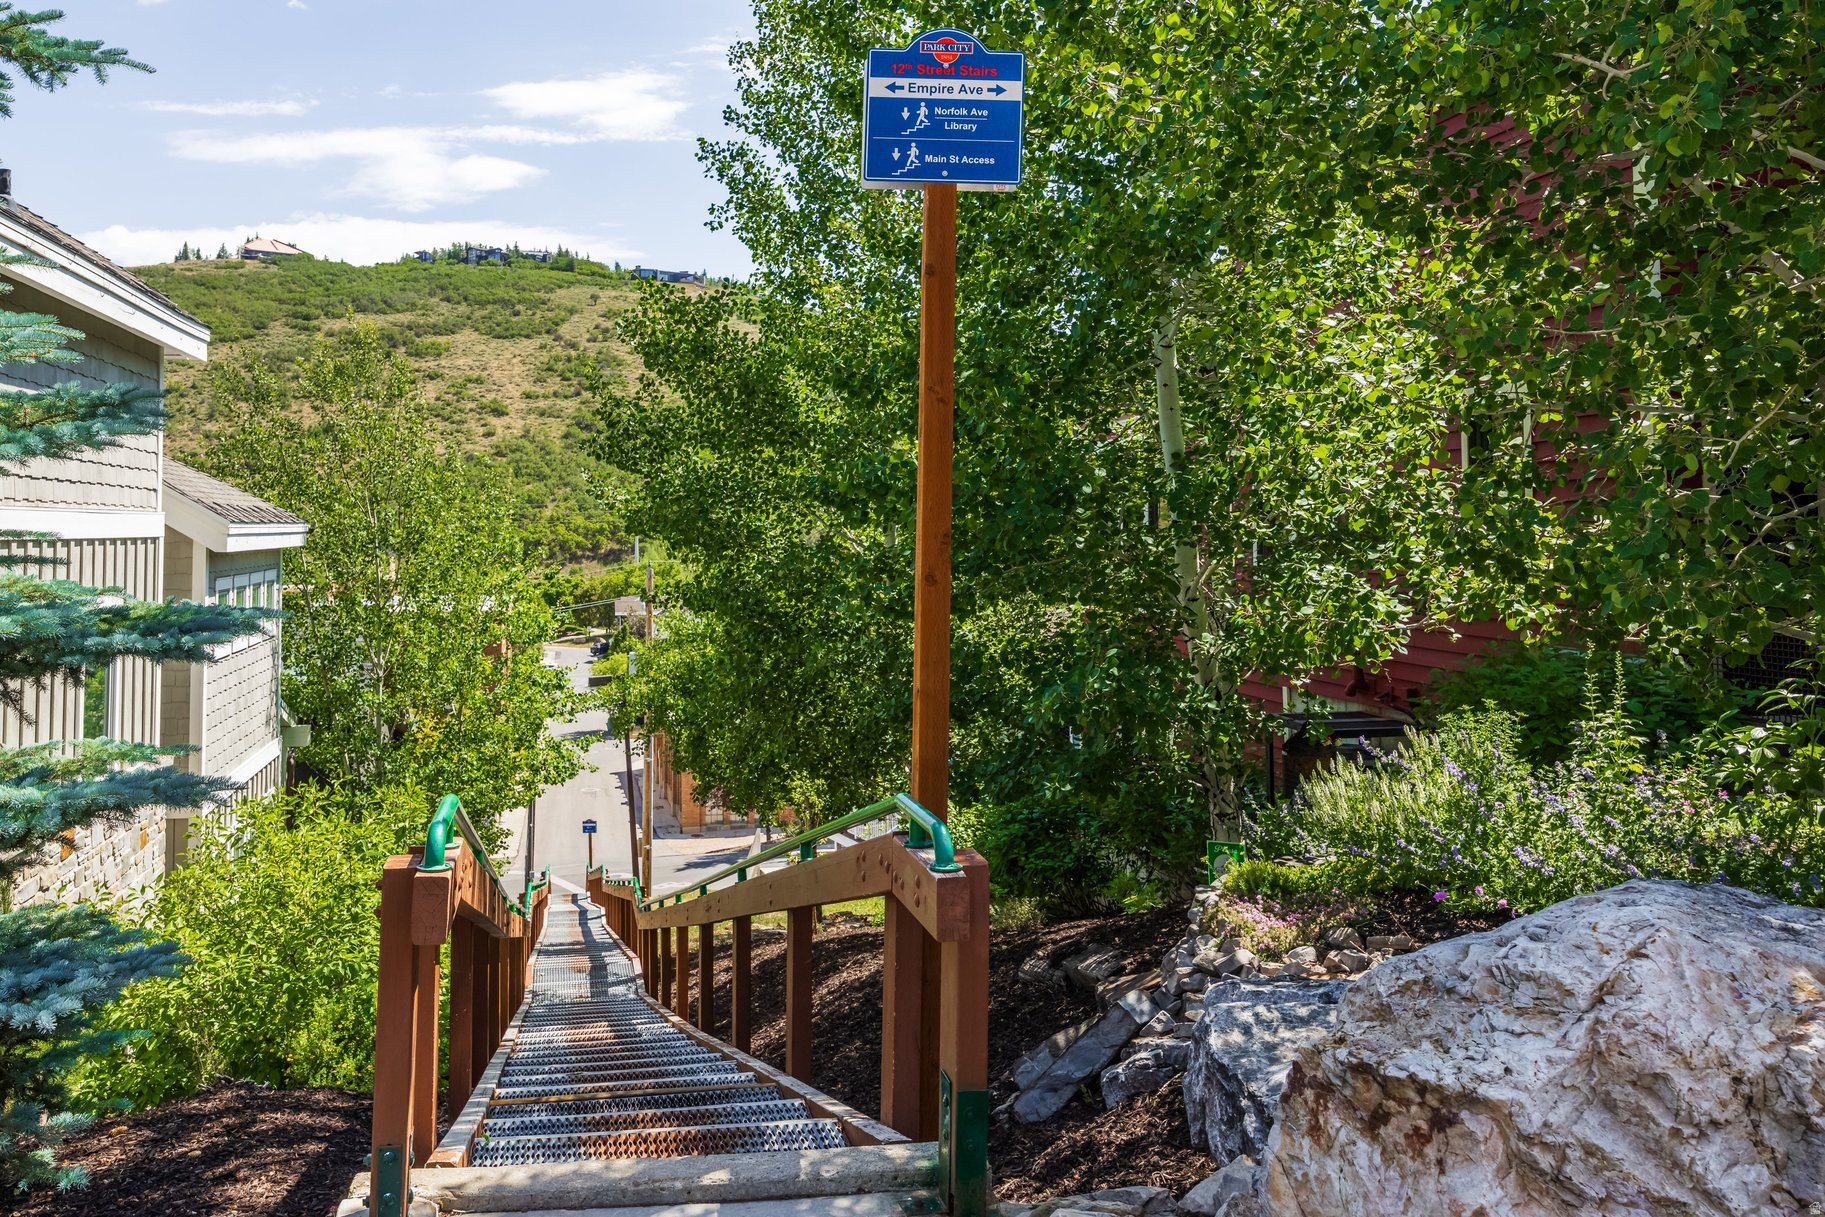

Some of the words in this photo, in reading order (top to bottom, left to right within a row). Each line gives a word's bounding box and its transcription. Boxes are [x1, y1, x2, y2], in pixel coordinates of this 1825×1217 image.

[924, 43, 946, 51] PARK
[948, 44, 970, 52] CITY
[891, 64, 912, 74] 12th
[917, 64, 955, 75] Street
[959, 66, 997, 76] Stairs
[908, 82, 954, 96] Empire
[958, 83, 984, 95] Ave
[934, 107, 968, 116] Norfolk
[970, 108, 988, 116] Ave
[944, 122, 977, 132] Library
[925, 155, 947, 163] Main
[949, 155, 960, 164] St
[961, 156, 995, 164] Access
